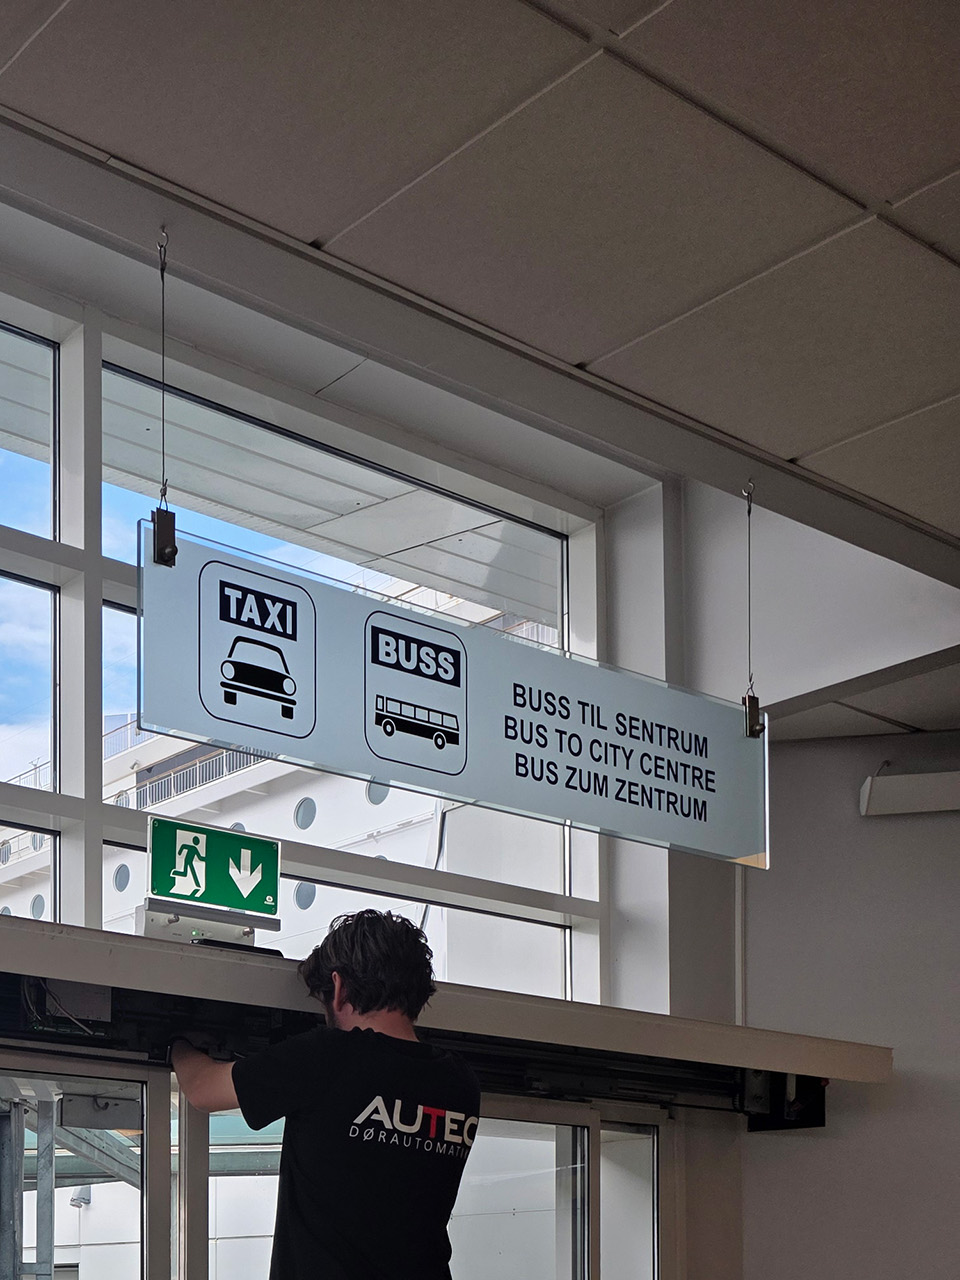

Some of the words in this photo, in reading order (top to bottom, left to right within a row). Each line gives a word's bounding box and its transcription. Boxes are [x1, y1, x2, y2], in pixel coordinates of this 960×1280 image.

[224, 587, 293, 635] TAXI
[378, 633, 455, 681] BUSS
[513, 682, 571, 720] BUSS
[578, 700, 608, 731] TIL
[615, 712, 708, 758] SENTRUM
[504, 715, 548, 748] BUS
[555, 729, 583, 757] TO
[589, 739, 634, 770] CITY
[640, 752, 716, 793] CENTRE
[515, 753, 558, 785] BUS
[565, 765, 609, 798] ZUM
[615, 778, 707, 822] ZENTRUM
[352, 1095, 479, 1147] AUTEC
